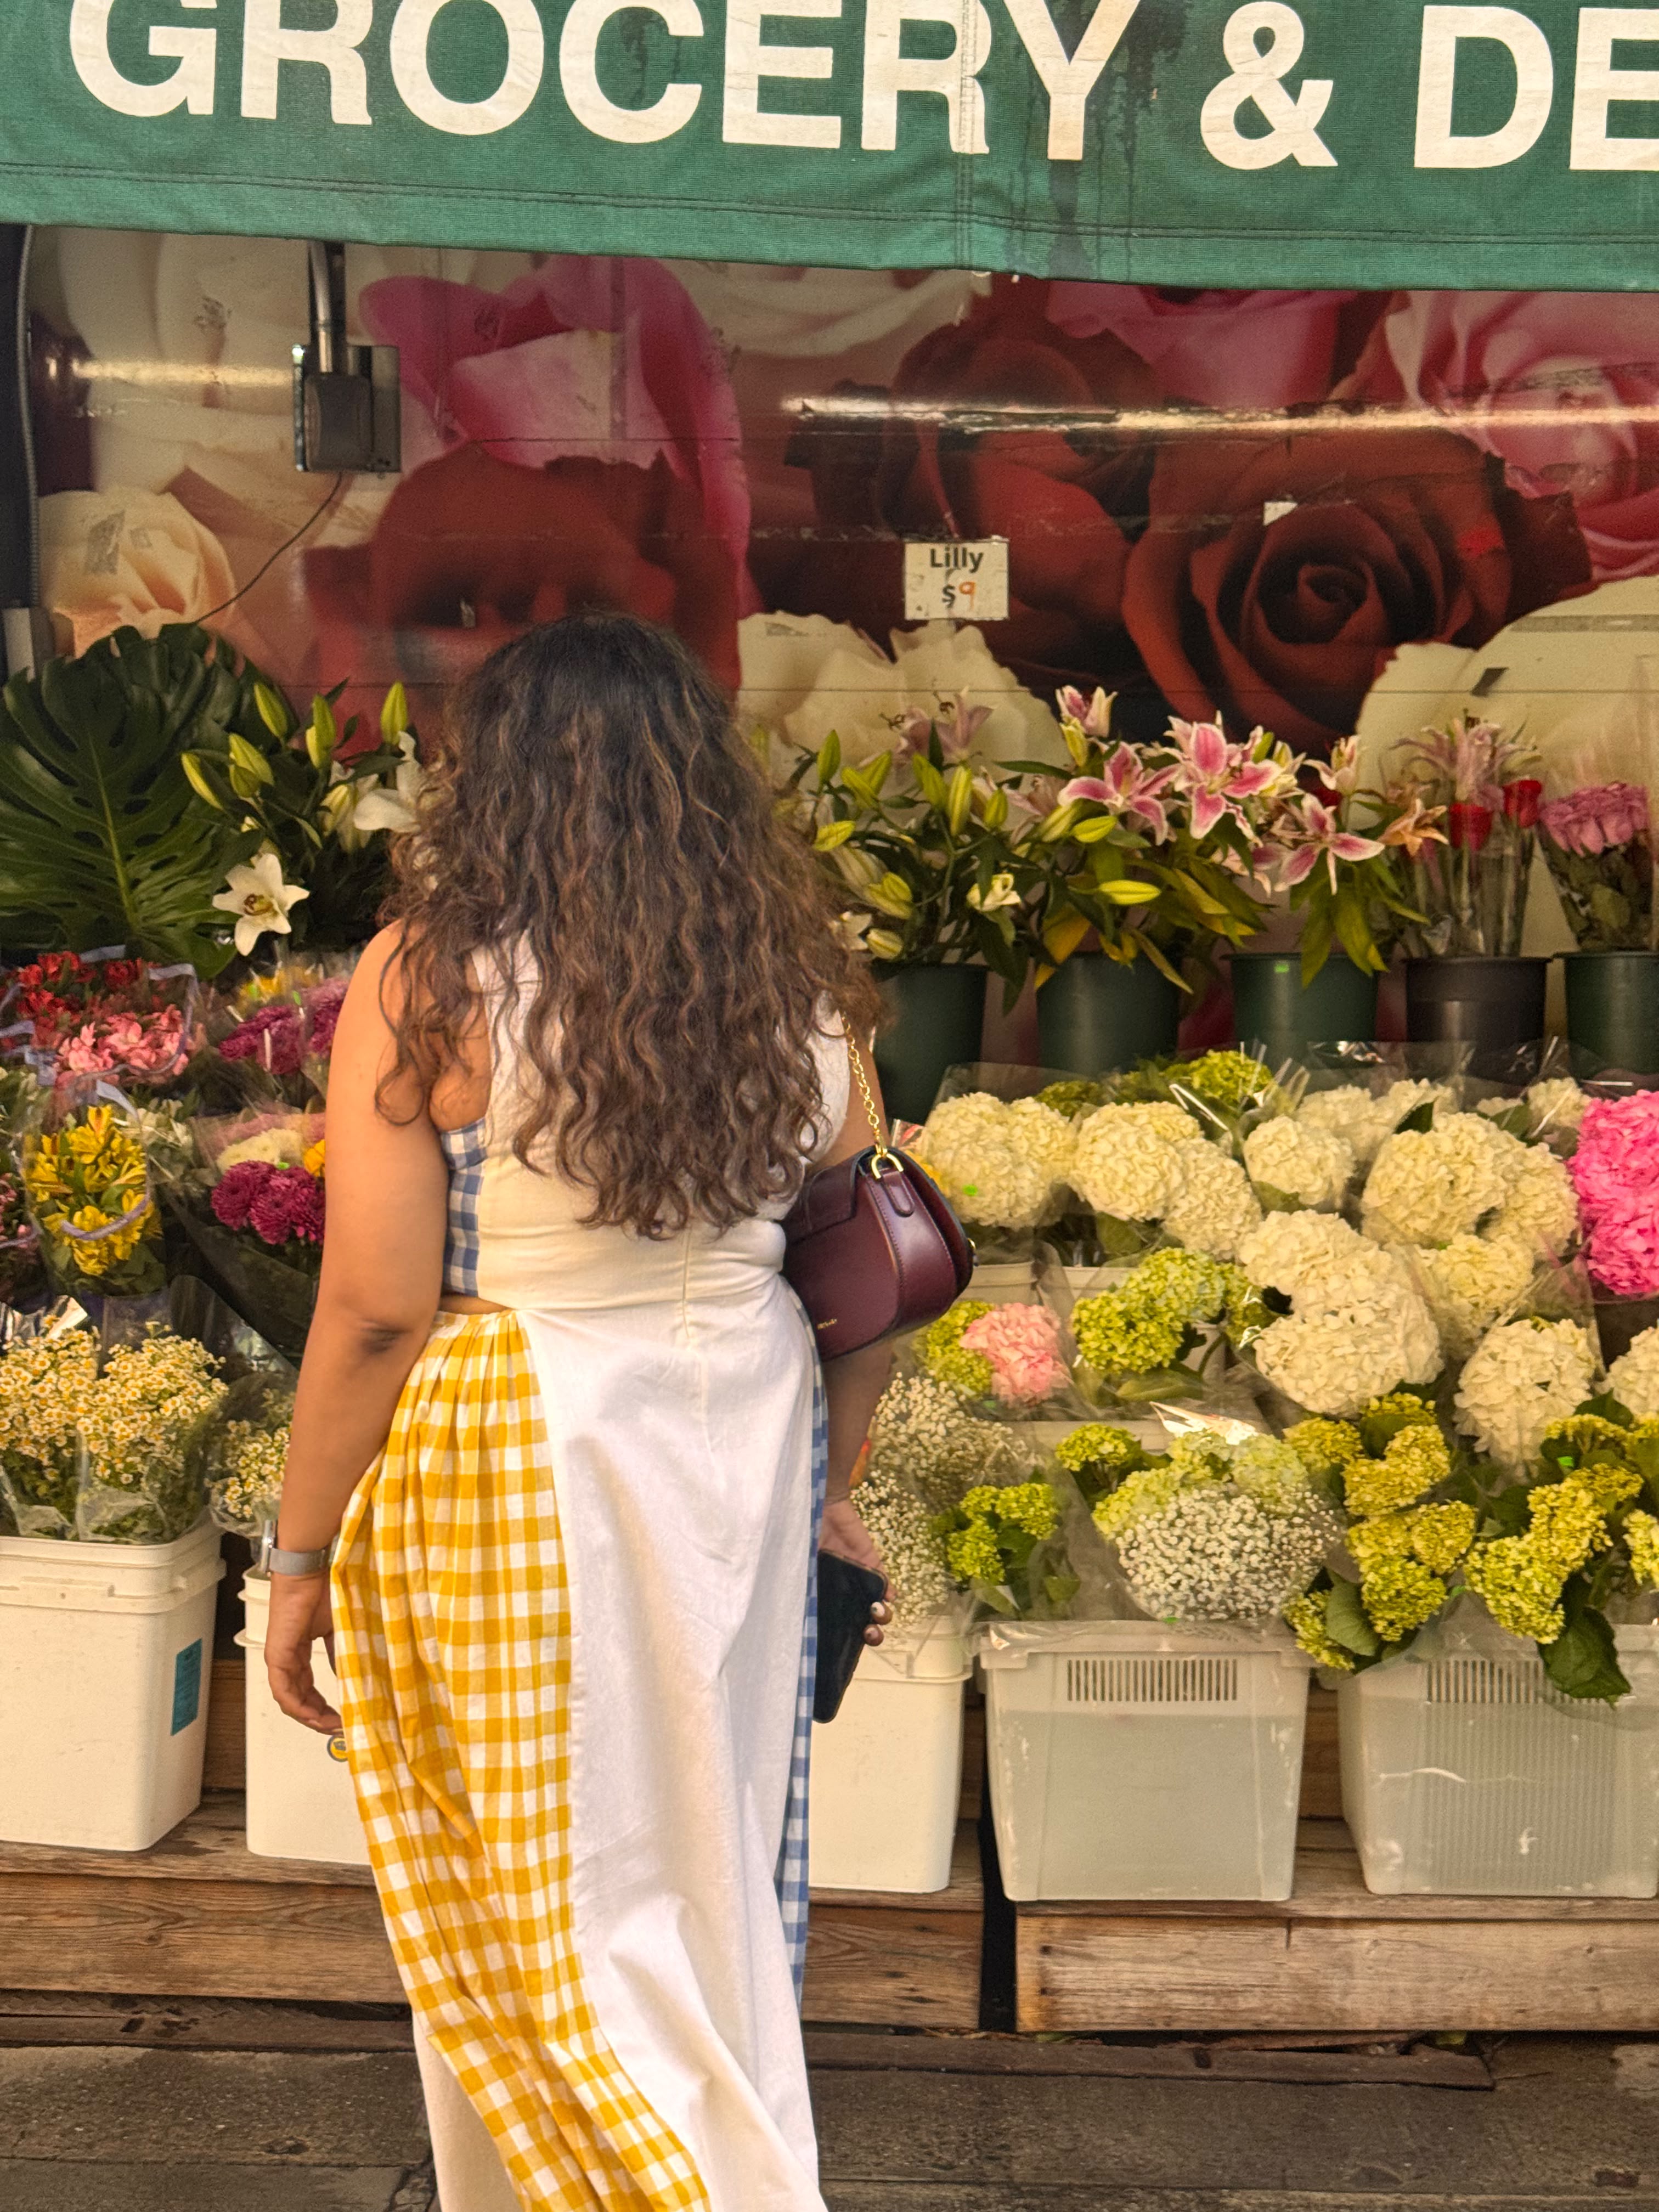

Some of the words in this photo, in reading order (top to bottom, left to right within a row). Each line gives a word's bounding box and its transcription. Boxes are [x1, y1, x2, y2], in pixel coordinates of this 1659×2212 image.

[70, 0, 1142, 160] GROCERY
[1201, 1, 1338, 170] &
[930, 547, 984, 573] Lilly
